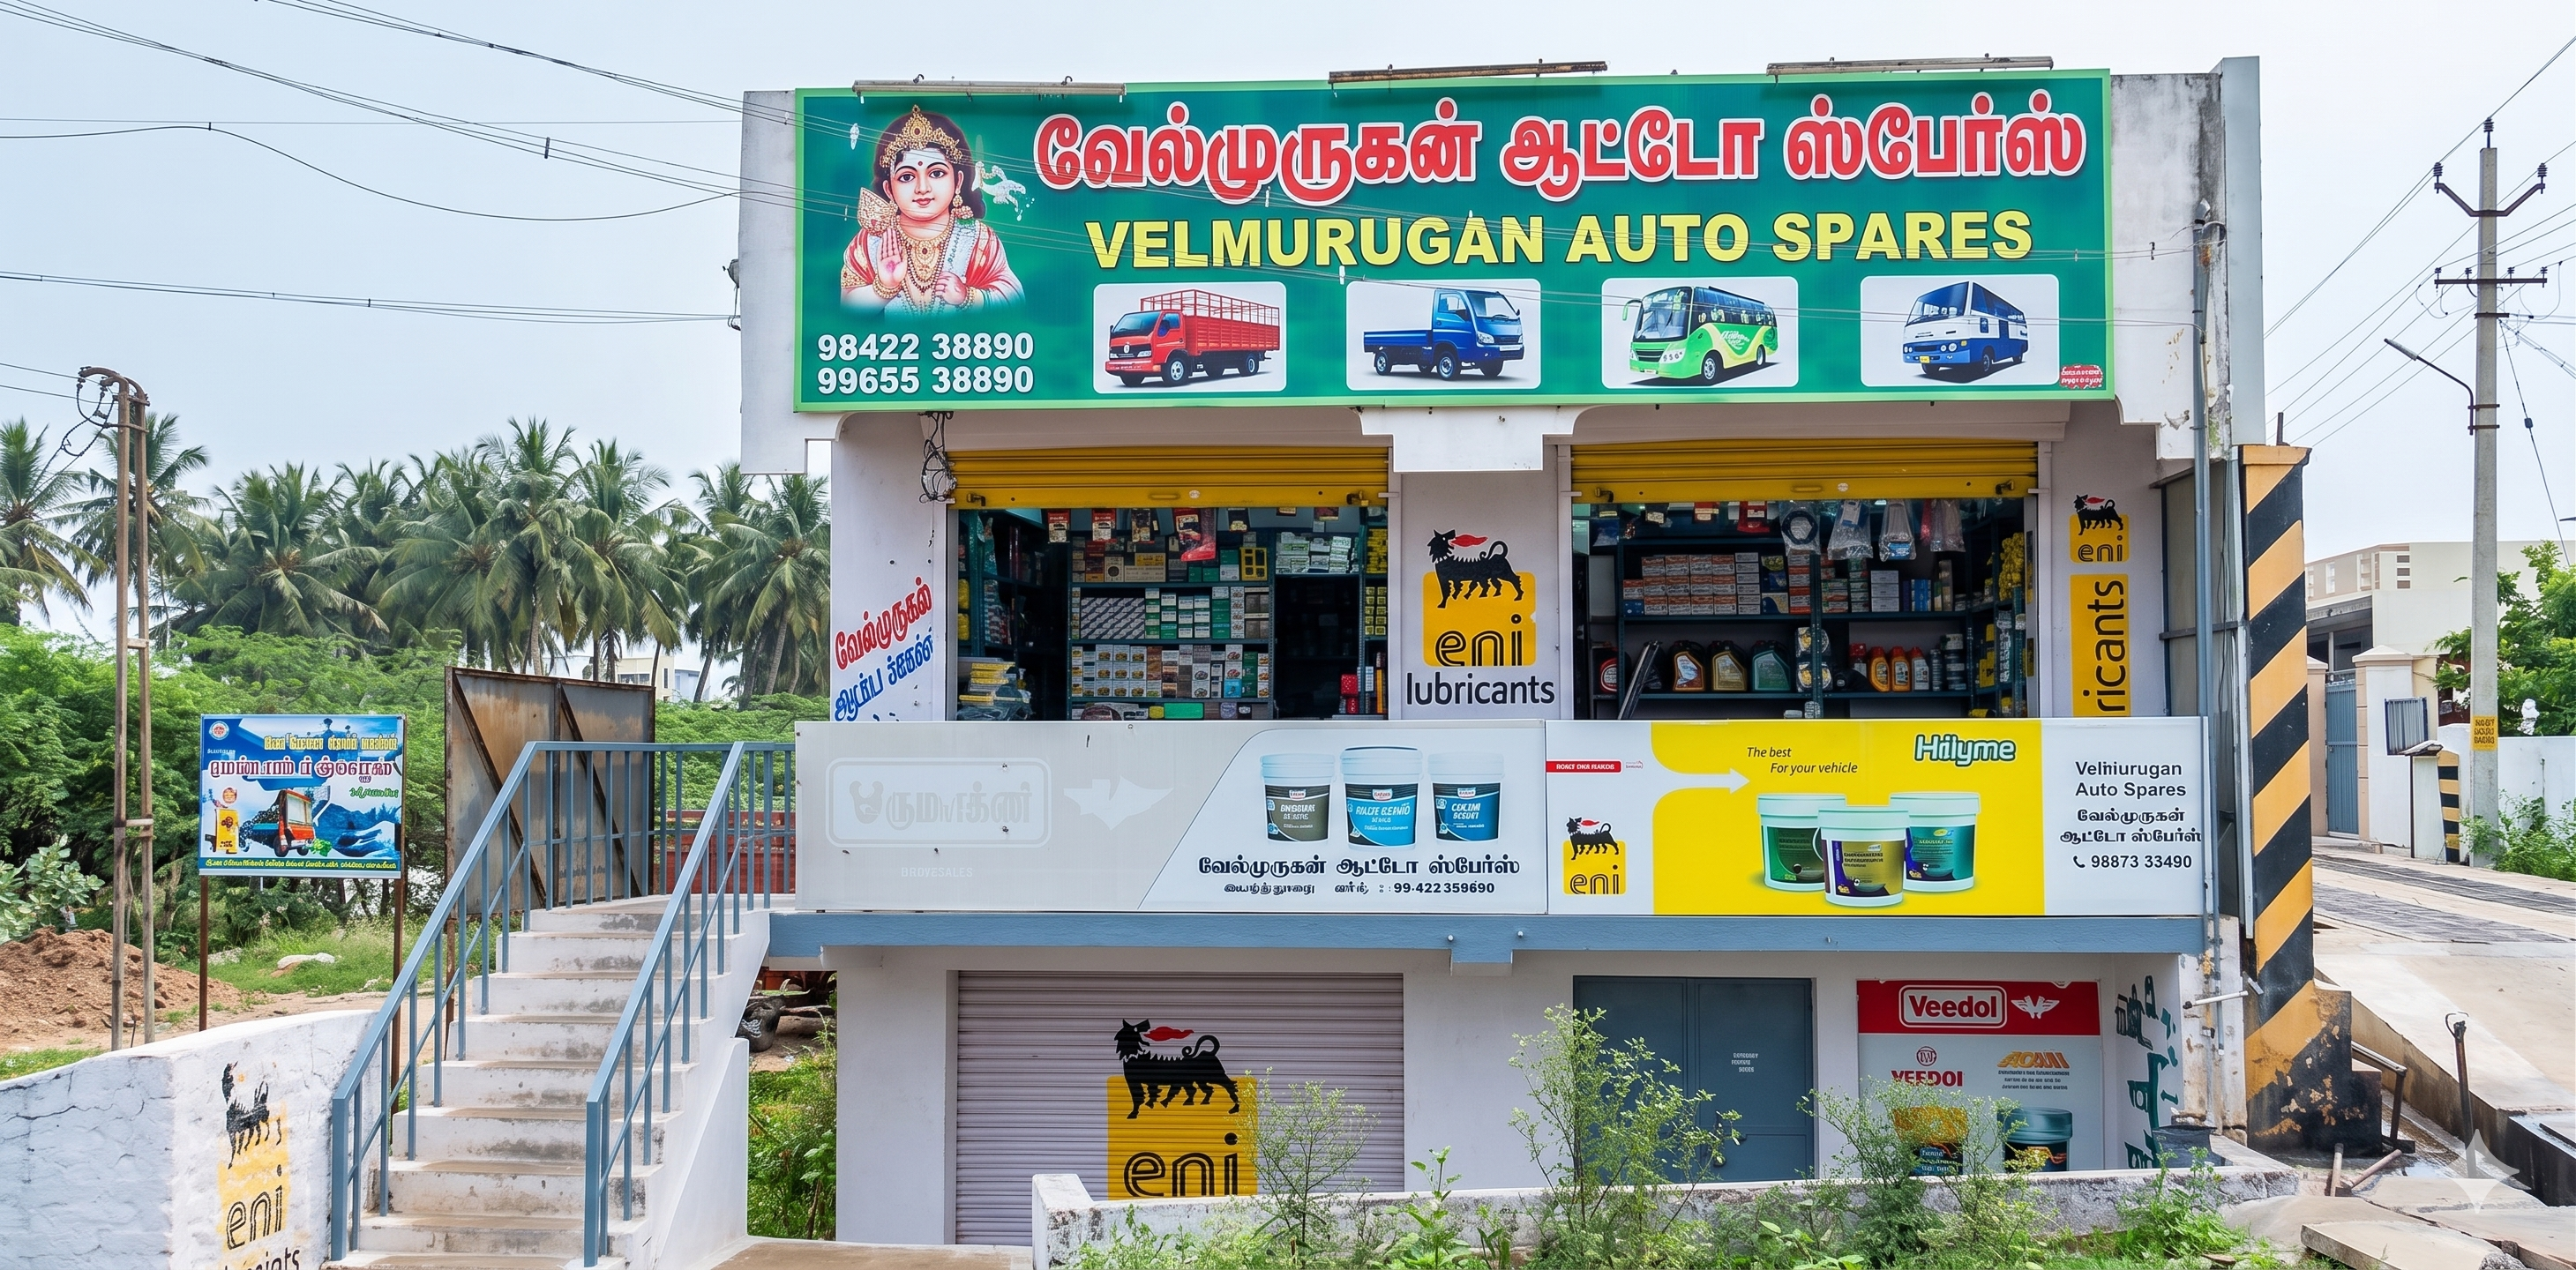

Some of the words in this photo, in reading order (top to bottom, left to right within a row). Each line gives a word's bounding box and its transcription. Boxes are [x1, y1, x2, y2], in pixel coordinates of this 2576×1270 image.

[1036, 100, 1479, 204] வேல்முருகன்
[1501, 108, 1763, 199] ஆட்டோ
[1786, 92, 2085, 177] ஸ்பேர்ஸ்
[1086, 217, 1544, 268] VELMURUGAN
[1567, 213, 1749, 263] AUTO
[1773, 210, 2033, 261] SPARES
[818, 333, 920, 361] 98422
[932, 332, 1035, 360] 38890
[818, 366, 920, 394] 99655
[932, 366, 1035, 393] 38890
[2078, 534, 2123, 563] eni
[1434, 613, 1523, 667] eni
[1406, 671, 1556, 706] lubricants
[1747, 746, 1767, 758] The
[1769, 746, 1792, 758] best
[1771, 762, 1788, 773] For
[1789, 765, 1816, 776] your
[1818, 762, 1858, 773] vehicle
[2075, 782, 2118, 796] Auto
[2123, 781, 2187, 800] Spares
[2059, 829, 2127, 845] ஆட்டோ
[1198, 854, 1327, 878] வேல்முருகன்
[1336, 856, 1419, 878] ஆட்டோ
[1428, 854, 1520, 874] ஸ்பேர்ஸ்
[2091, 855, 2139, 869] 98873
[2144, 855, 2192, 869] 33490
[1569, 864, 1620, 894] eni
[1909, 995, 1998, 1019] Veedol
[1123, 1132, 1239, 1198] eni
[226, 1162, 283, 1251] eni
